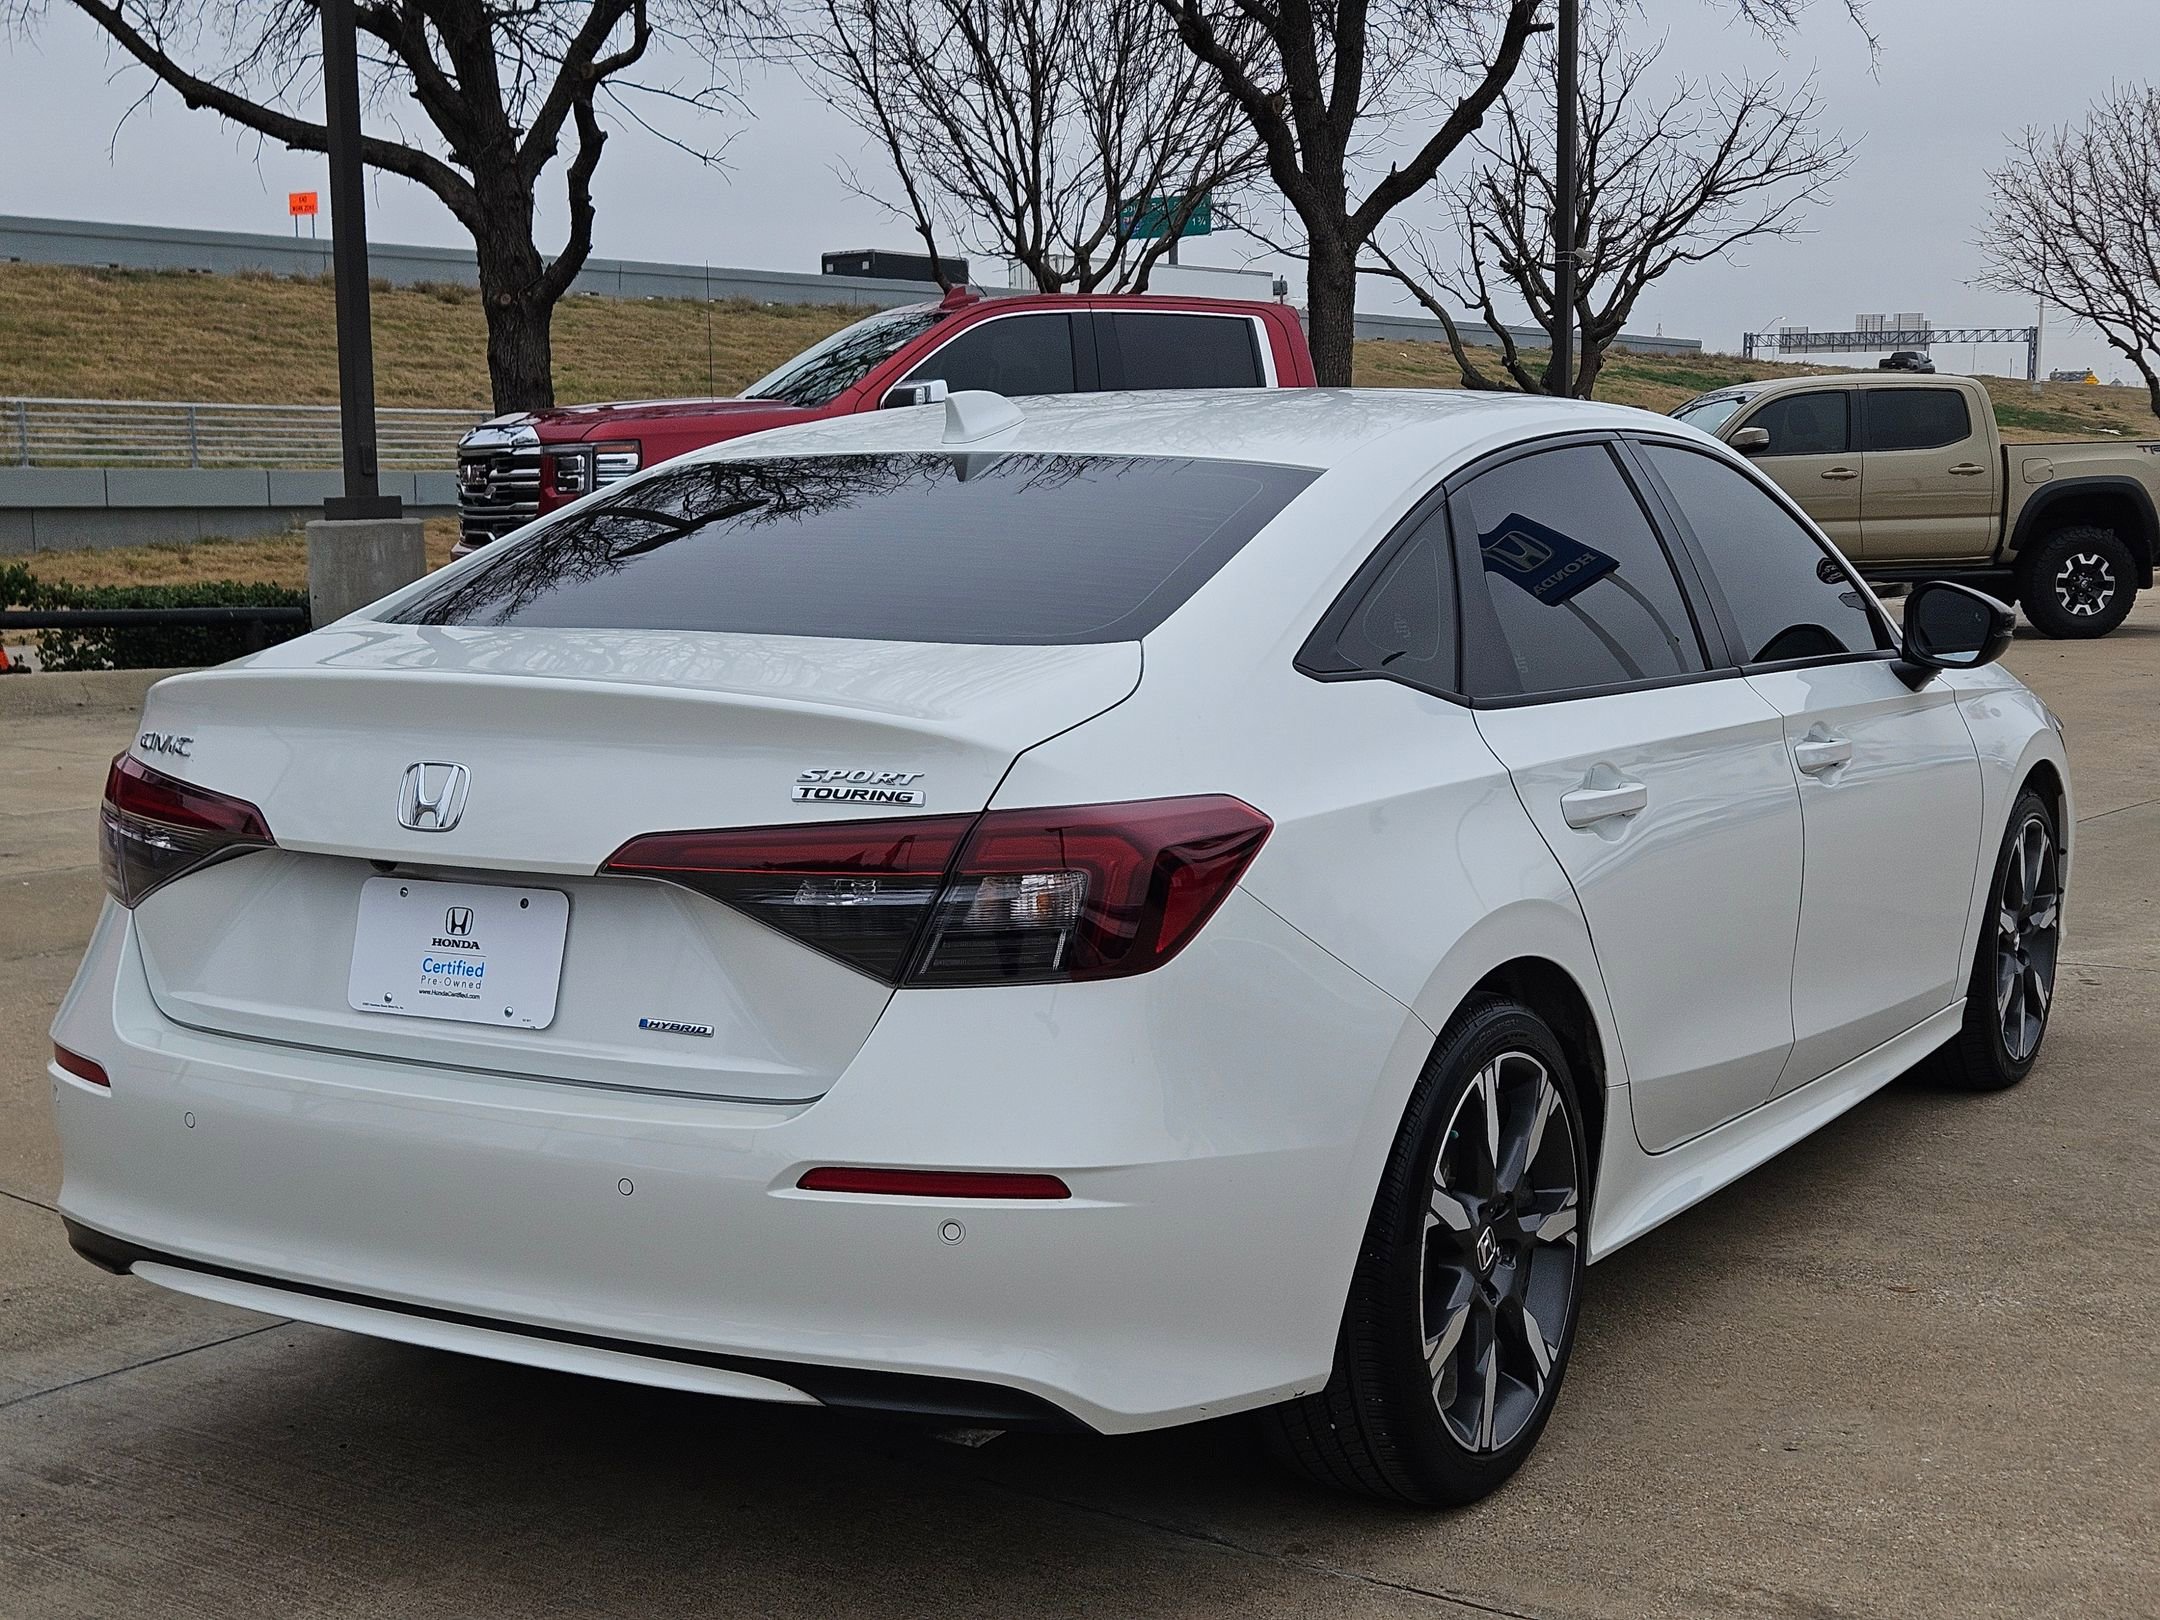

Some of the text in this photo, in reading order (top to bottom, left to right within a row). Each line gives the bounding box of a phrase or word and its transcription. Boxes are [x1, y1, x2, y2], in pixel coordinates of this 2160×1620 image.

[796, 769, 925, 786] SPORT
[799, 787, 915, 803] TOURING
[431, 937, 481, 950] HONDA
[422, 957, 485, 978] Certified
[420, 974, 482, 990] Pre-Owned
[648, 1020, 708, 1034] HYBRID
